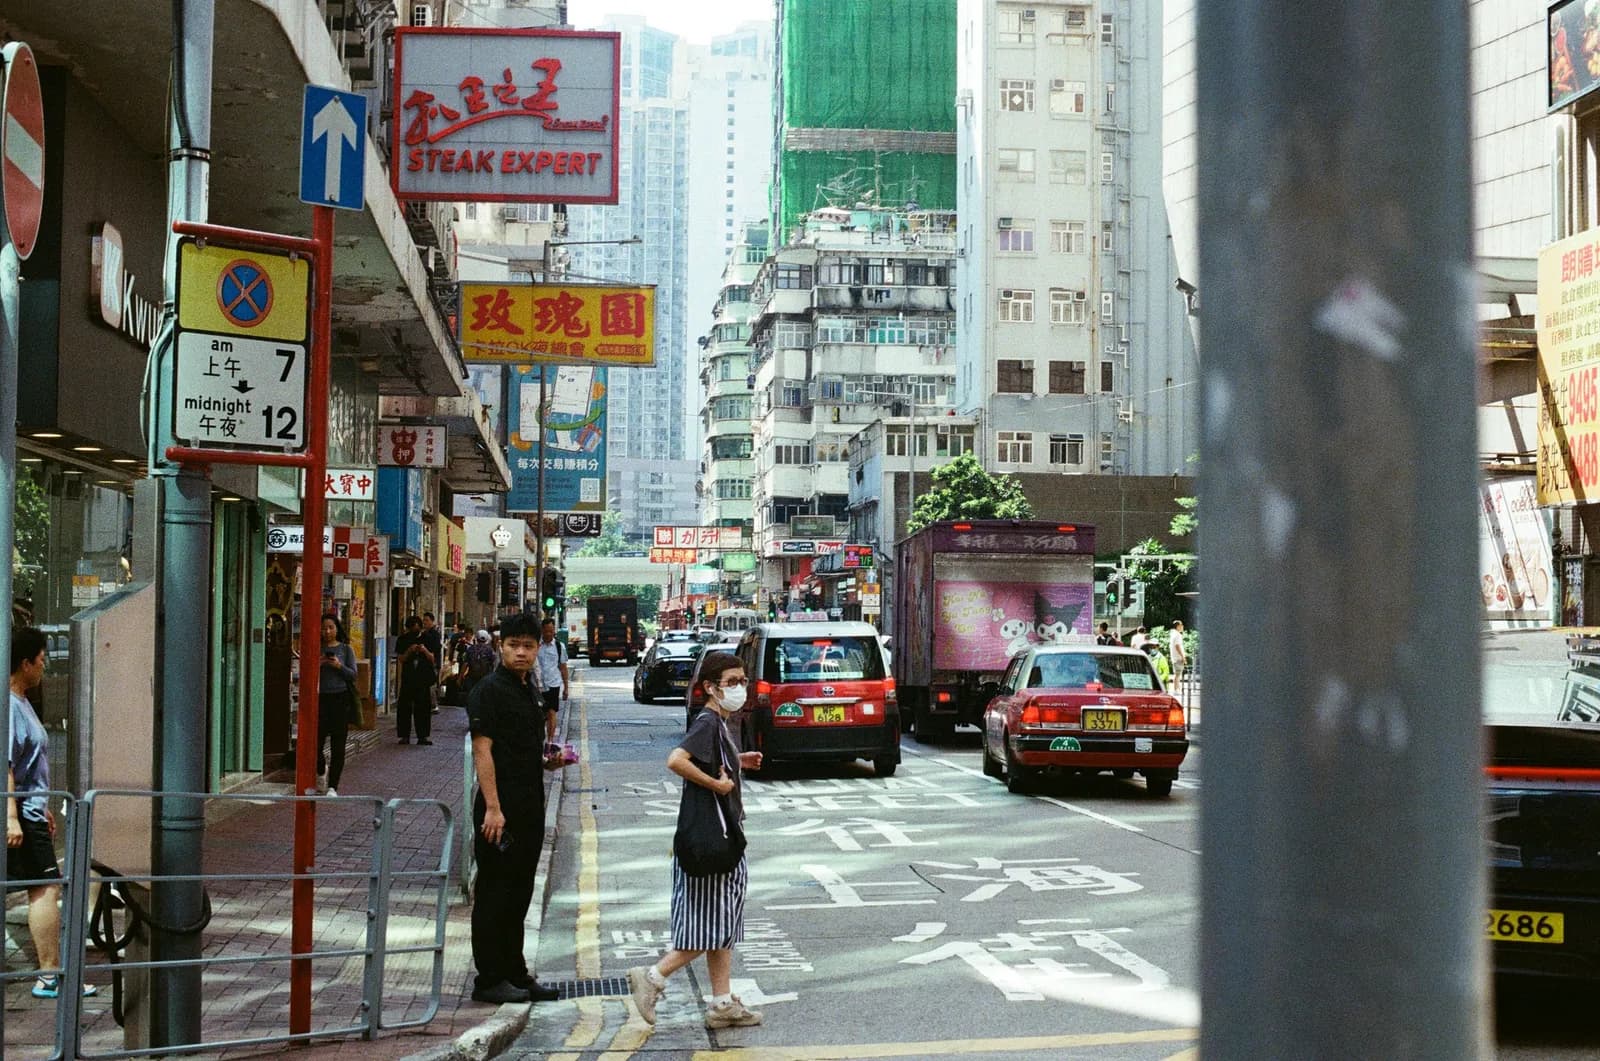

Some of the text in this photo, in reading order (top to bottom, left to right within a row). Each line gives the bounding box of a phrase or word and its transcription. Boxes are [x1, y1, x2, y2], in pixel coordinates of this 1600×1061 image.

[407, 148, 603, 176] STEAK EXPERT
[469, 288, 646, 339] 玫瑰園
[211, 339, 234, 353] am
[203, 355, 242, 379] 上午
[276, 349, 296, 383] 7
[184, 395, 252, 418] midnight
[1569, 367, 1598, 426] 9495
[199, 413, 238, 439] 午夜
[262, 404, 298, 441] 12
[517, 457, 599, 471] 每次交易賺積分
[1569, 432, 1598, 490] 9488
[817, 714, 842, 722] 6128
[1091, 720, 1117, 729] 3371
[764, 857, 1145, 911] 上海
[735, 940, 815, 972] RIGHT
[891, 918, 1171, 1002] 街
